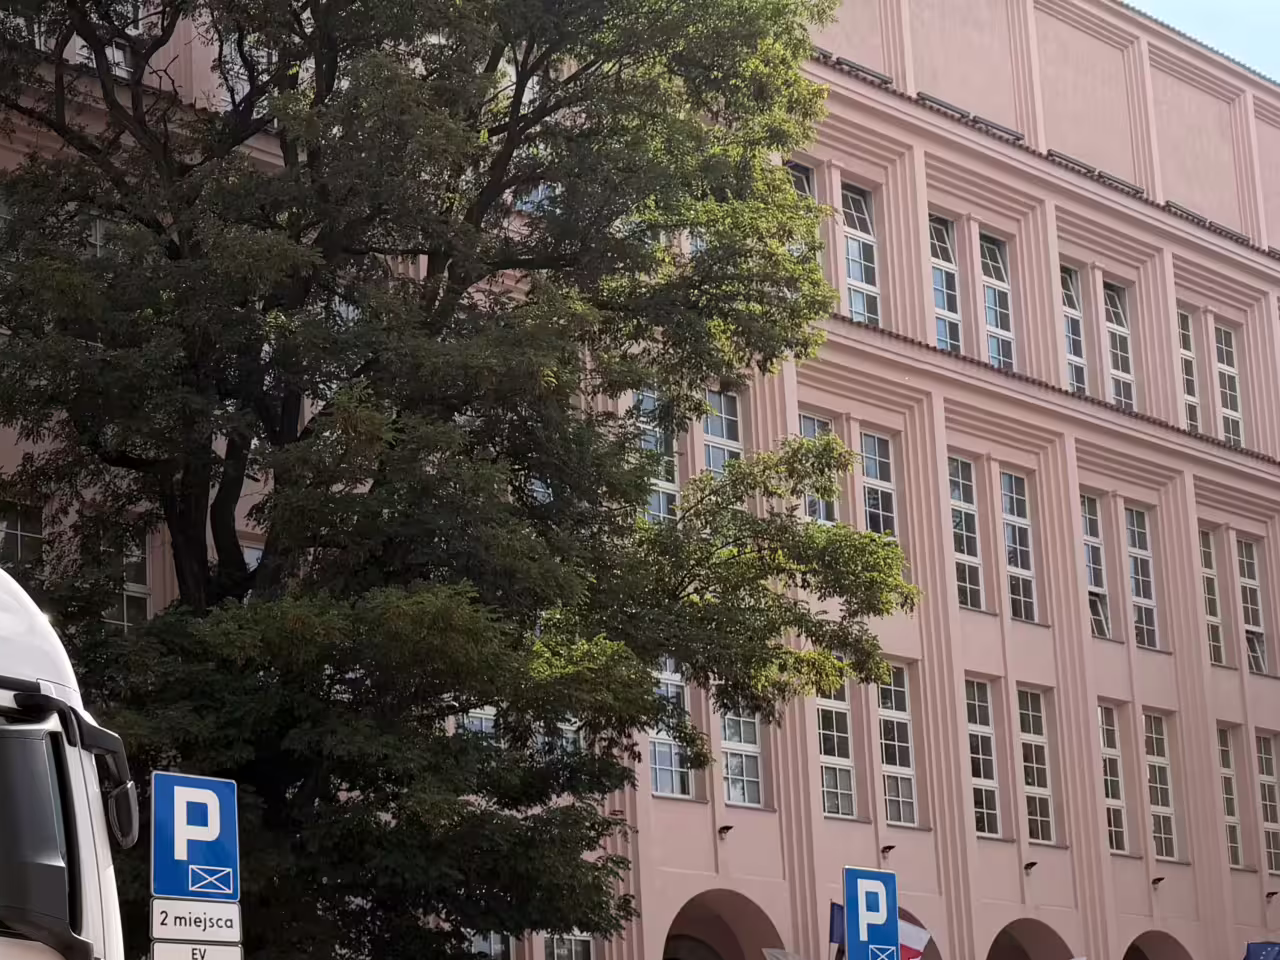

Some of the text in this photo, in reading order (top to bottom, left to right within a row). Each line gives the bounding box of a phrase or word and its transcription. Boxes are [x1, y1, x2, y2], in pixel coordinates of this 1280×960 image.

[174, 785, 220, 861] P
[159, 910, 234, 932] 2 miejsca
[856, 878, 888, 942] P
[191, 947, 207, 960] EV
